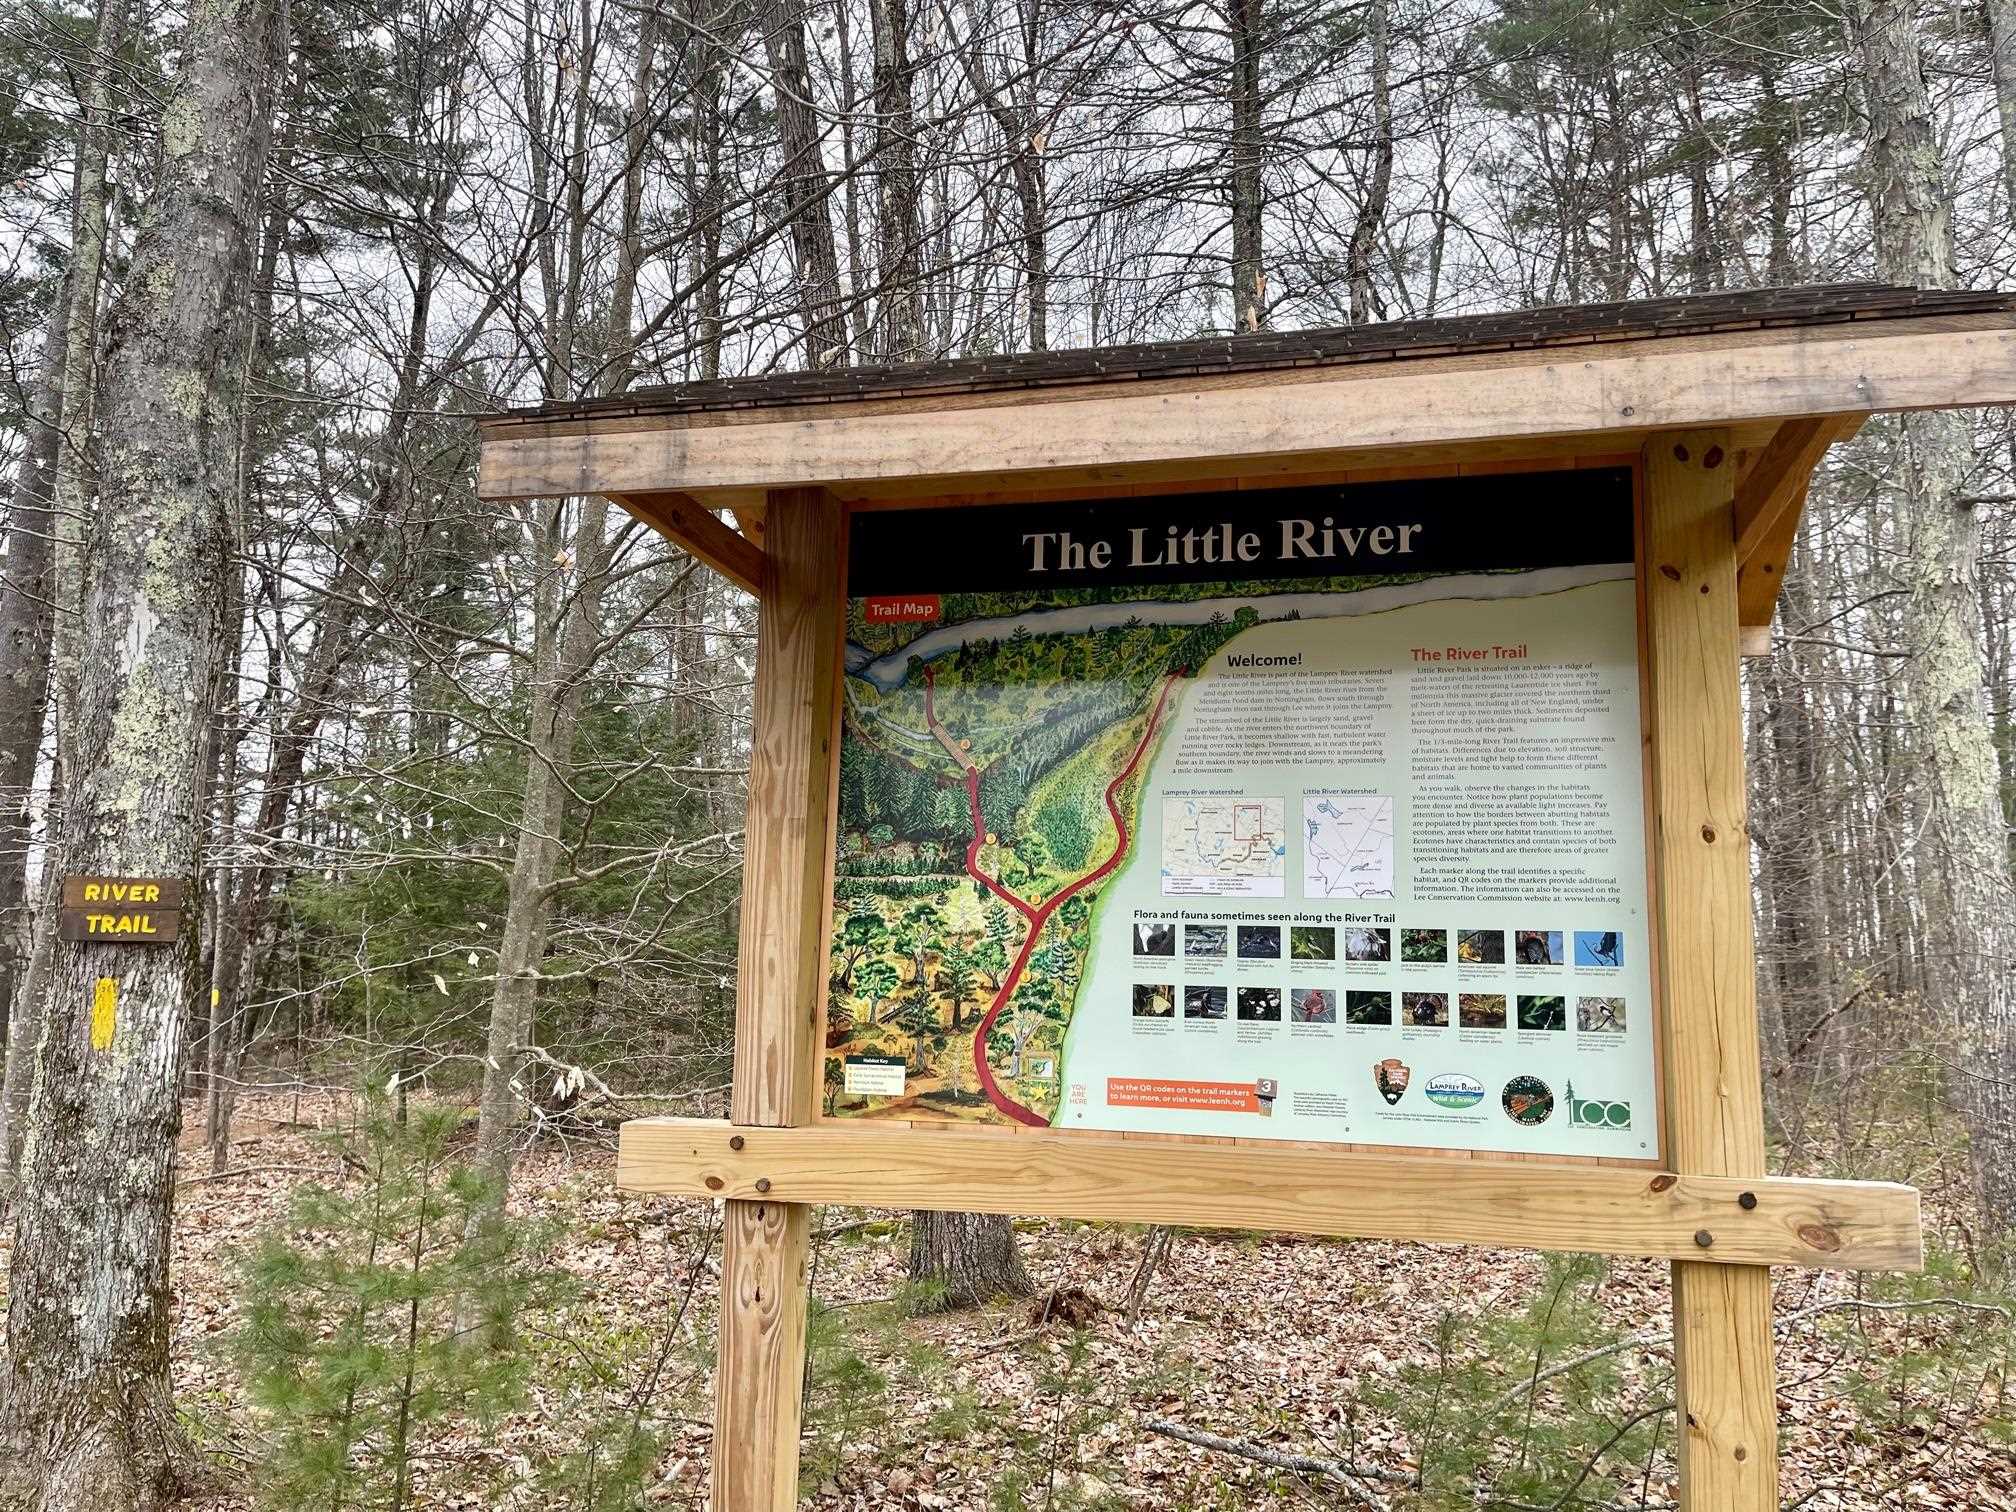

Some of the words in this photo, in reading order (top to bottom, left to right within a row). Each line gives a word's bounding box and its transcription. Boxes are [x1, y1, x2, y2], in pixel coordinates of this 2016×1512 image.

[1022, 529, 1112, 572] The
[1127, 522, 1261, 568] Little
[1277, 517, 1423, 560] River
[872, 603, 901, 617] Trail
[903, 602, 933, 618] Map
[1411, 649, 1441, 662] The
[1447, 648, 1488, 661] River
[1492, 645, 1528, 660] Trail
[1227, 653, 1303, 667] Welcome!
[1162, 788, 1189, 797] Lamprey
[1425, 820, 1460, 828] populated
[1461, 820, 1470, 828] by
[1472, 819, 1491, 828] plant
[1492, 819, 1518, 828] species
[1562, 837, 1587, 846] species
[1582, 846, 1608, 855] greater
[1465, 867, 1485, 876] along
[1548, 876, 1576, 885] provide
[84, 883, 160, 903] RIVER
[1564, 894, 1620, 903] www.leenh.org
[1134, 910, 1157, 919] Flora
[1160, 910, 1178, 919] and
[1181, 910, 1208, 920] fauna
[1211, 911, 1264, 921] sometimes
[1293, 912, 1322, 924] along
[1325, 913, 1341, 922] the
[1344, 913, 1370, 922] River
[1375, 914, 1395, 923] Trail
[86, 914, 157, 934] TRAIL
[1261, 1081, 1272, 1092] 3
[1218, 1088, 1249, 1097] markers
[1189, 1097, 1246, 1106] www.leenh.org
